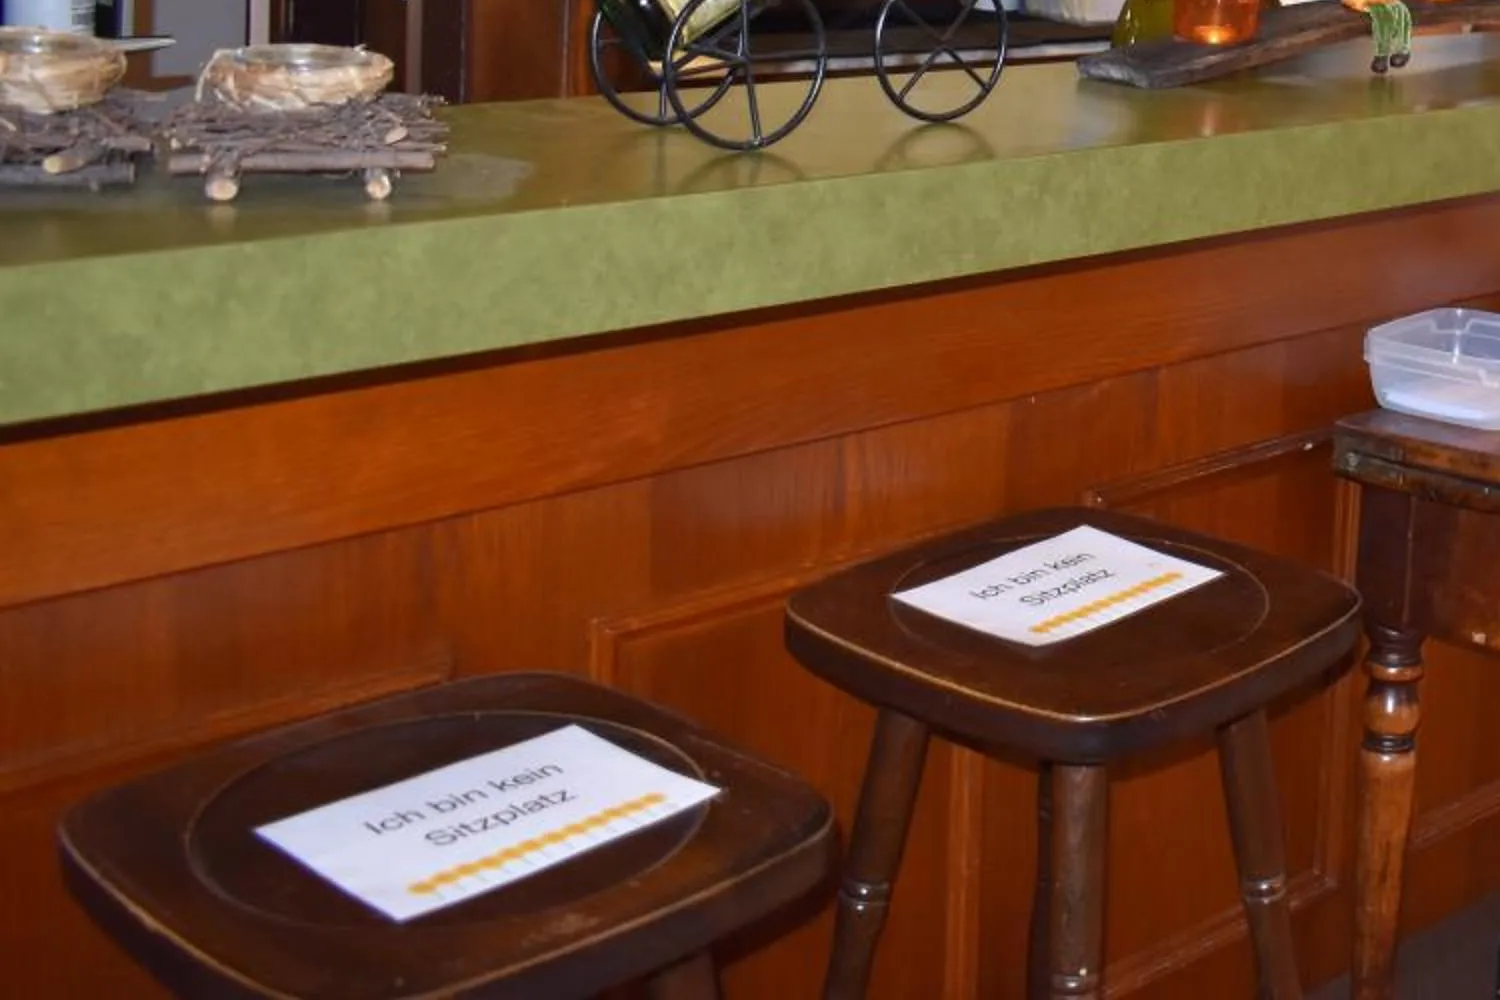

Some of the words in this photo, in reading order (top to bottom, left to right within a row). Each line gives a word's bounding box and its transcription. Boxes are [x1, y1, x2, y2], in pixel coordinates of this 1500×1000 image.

[968, 582, 1012, 600] Ich
[1008, 568, 1046, 586] bin
[1044, 553, 1095, 569] kein
[1019, 568, 1117, 607] Sitzplatz
[363, 809, 427, 835] Ich
[425, 788, 489, 814] bin
[487, 763, 565, 792] kein
[424, 789, 577, 847] Sitzplatz
